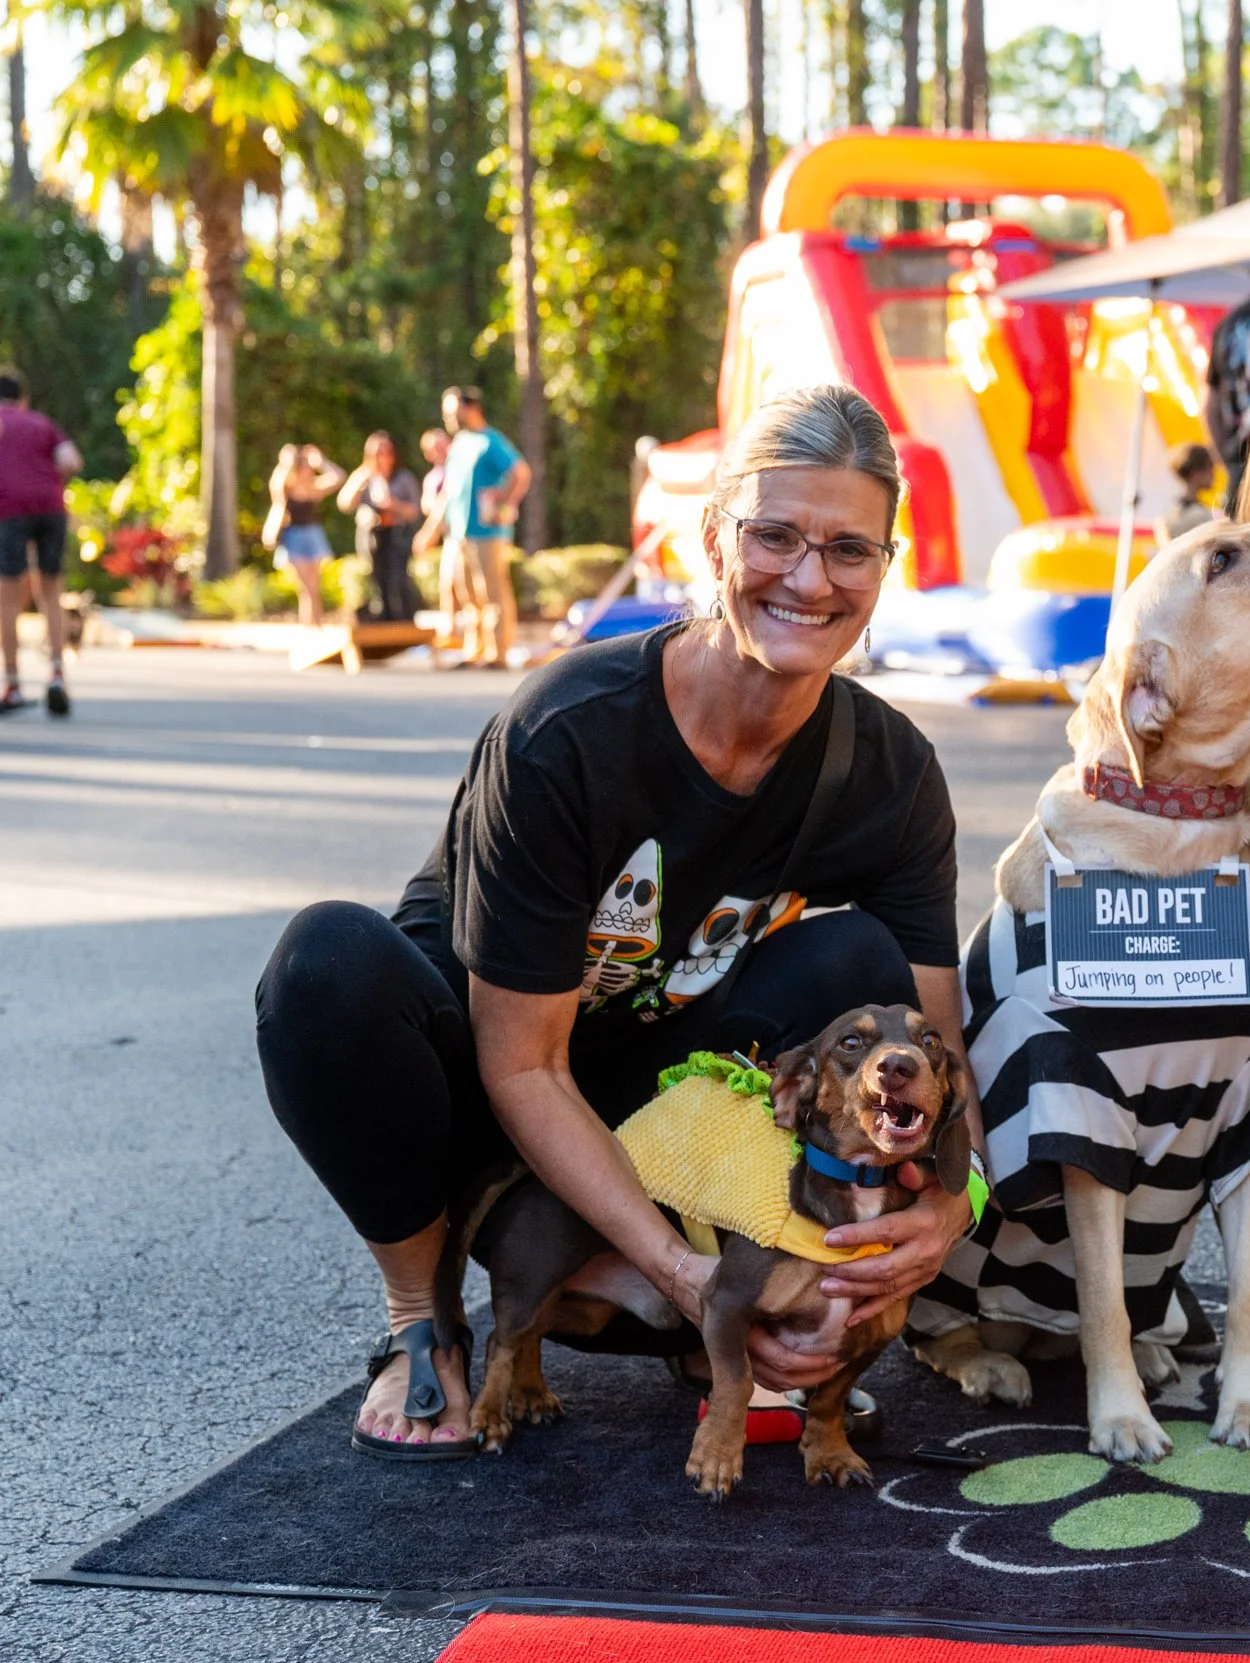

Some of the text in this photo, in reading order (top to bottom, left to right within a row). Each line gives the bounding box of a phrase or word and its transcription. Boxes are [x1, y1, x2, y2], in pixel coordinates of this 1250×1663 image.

[1095, 887, 1207, 925] BAD PET
[1124, 935, 1181, 955] CHARGE:
[1064, 962, 1235, 995] Jumping on people!
